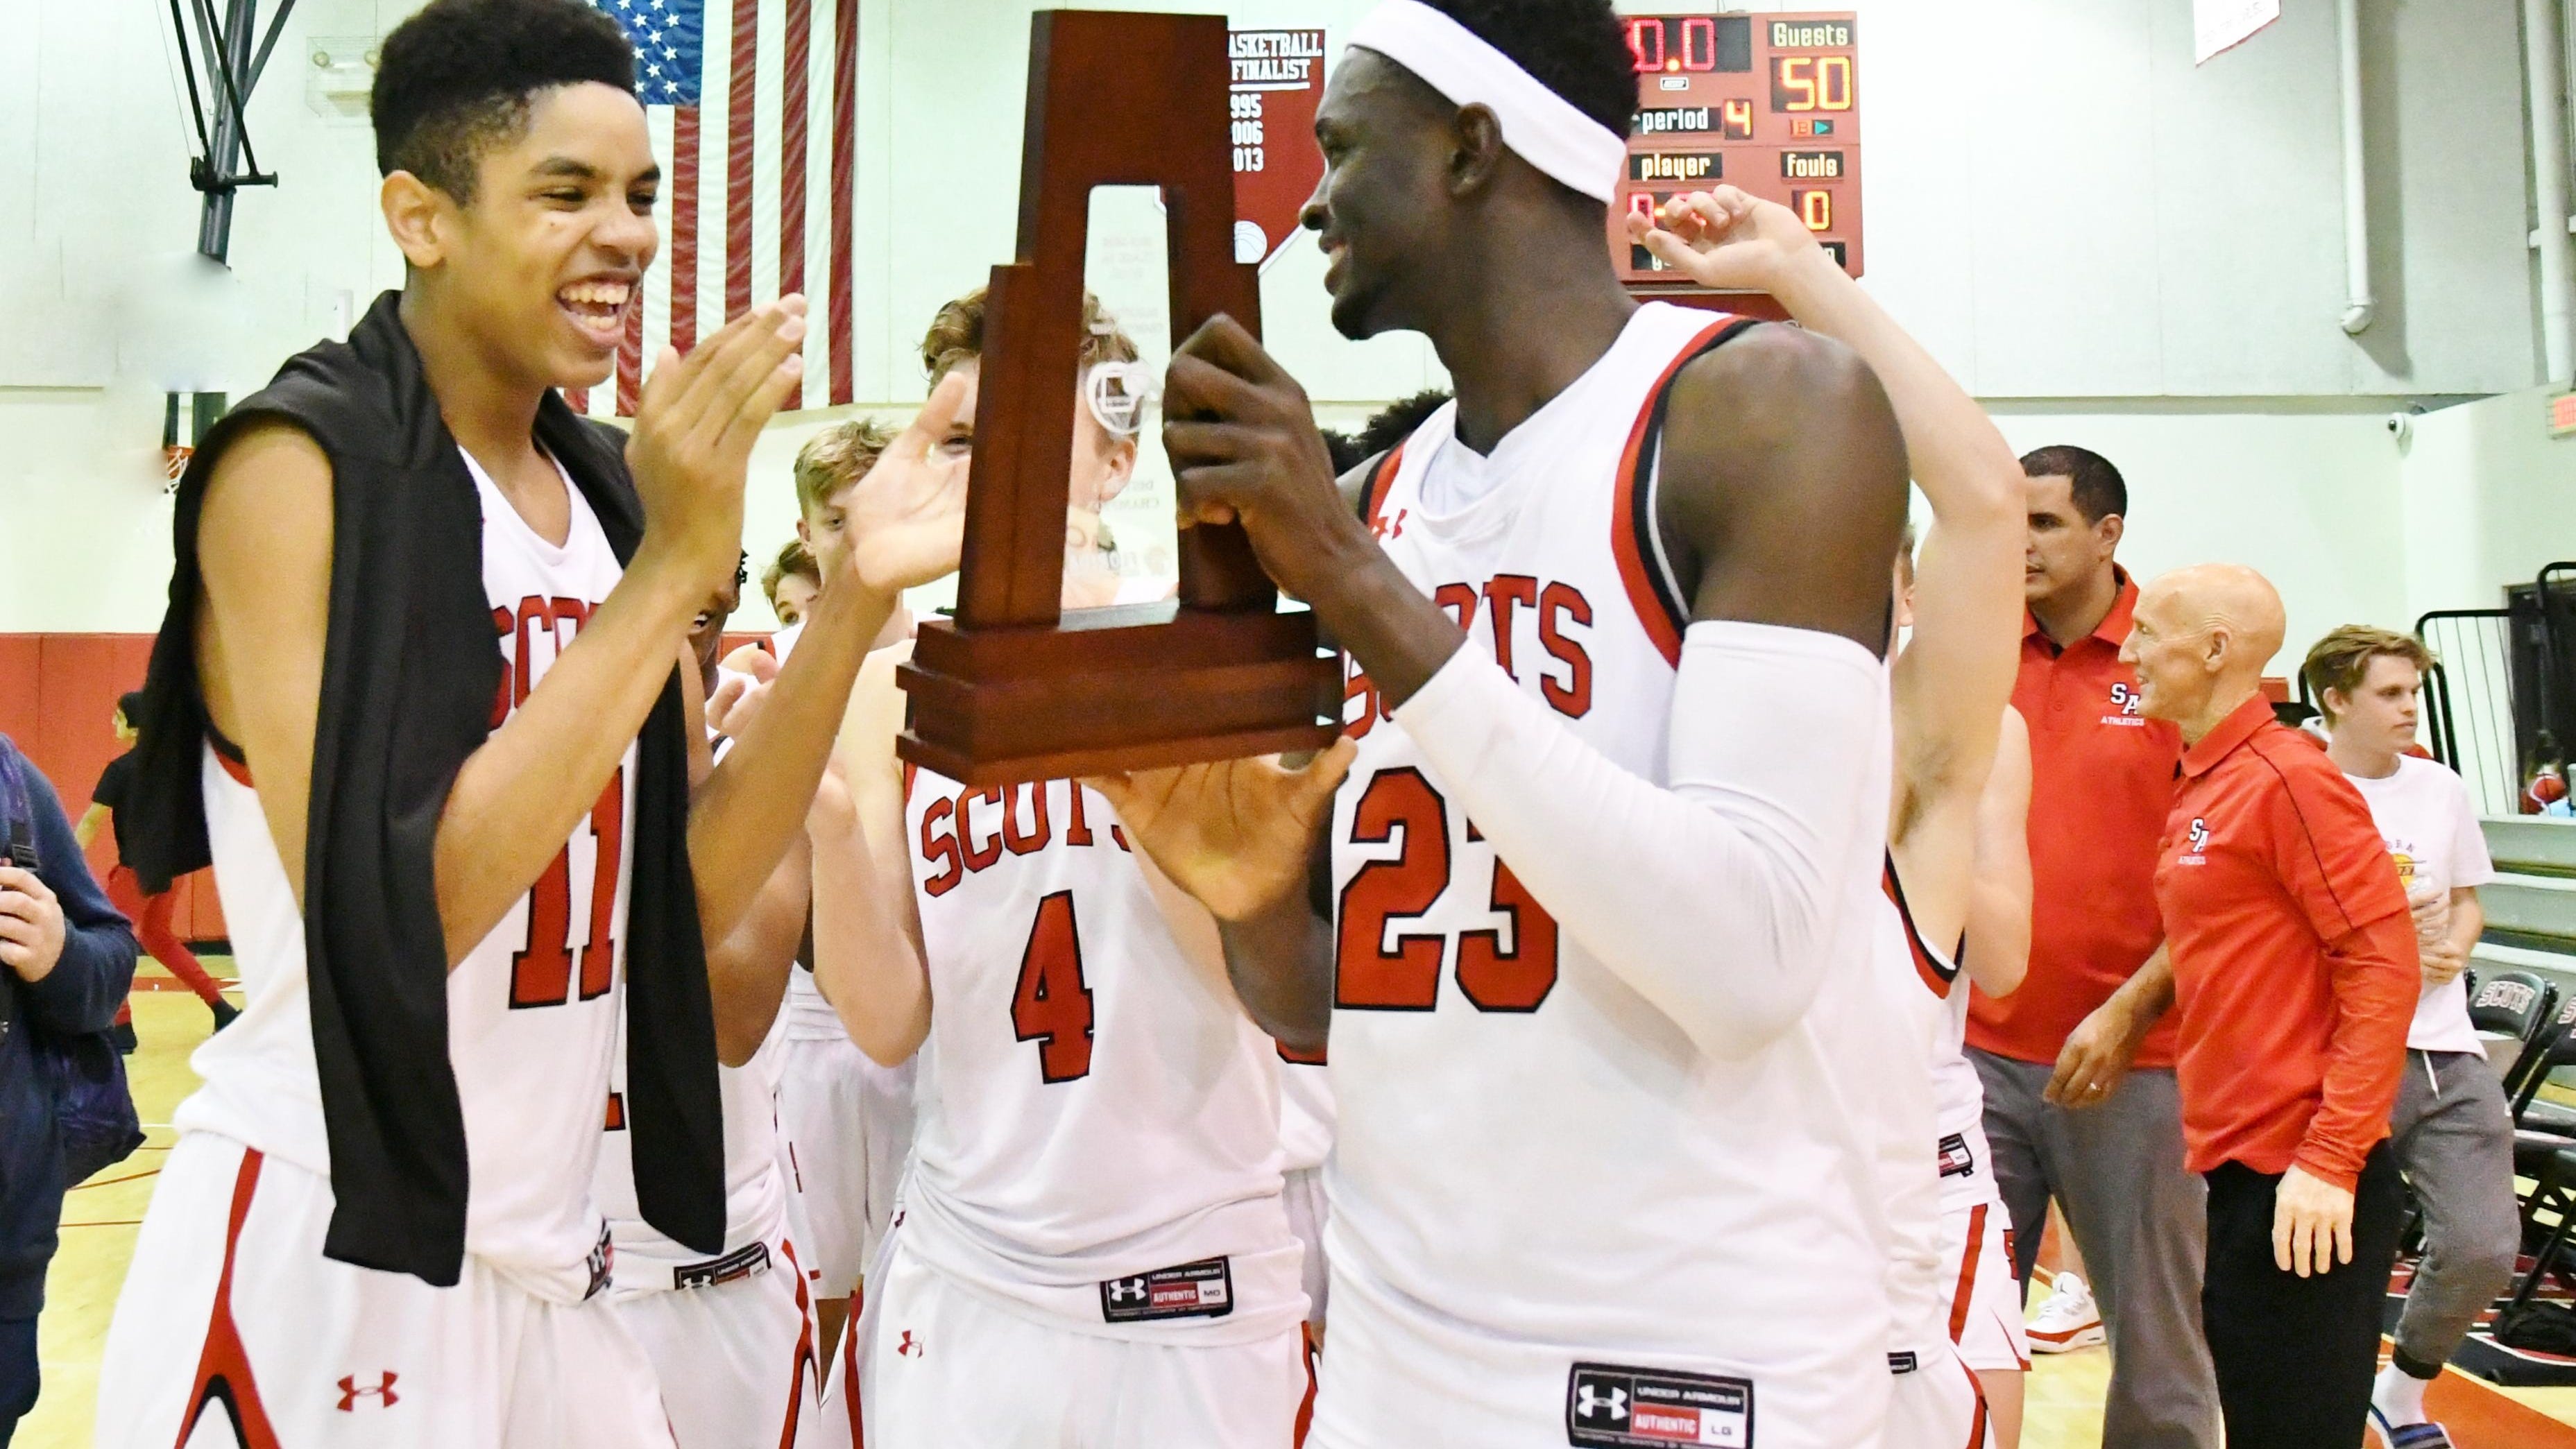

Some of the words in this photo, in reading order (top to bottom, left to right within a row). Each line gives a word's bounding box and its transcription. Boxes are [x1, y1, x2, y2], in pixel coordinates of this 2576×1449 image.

[1228, 33, 1322, 58] ASKETBALL
[1774, 22, 1848, 47] Guests
[1231, 59, 1311, 80] FINALIST
[1781, 56, 1850, 110] 50
[1230, 94, 1262, 119] 995
[1641, 108, 1709, 135] period
[1726, 101, 1751, 135] 4
[1231, 120, 1263, 145] 006
[1233, 147, 1264, 172] 013
[1641, 154, 1711, 181] player
[1787, 153, 1838, 178] fouls
[1805, 191, 1829, 231] 0
[1334, 766, 1558, 1013] 23
[1010, 889, 1095, 1084] 4
[2475, 980, 2536, 1015] SCOTS
[1152, 1271, 1182, 1280] UNDER
[1184, 1269, 1222, 1277] ARMOUR
[1153, 1289, 1197, 1303] AUTHENTIC
[1637, 1387, 1680, 1399] UNDER
[1682, 1390, 1741, 1405] ARMOUR
[1635, 1414, 1697, 1434] AUTHENTIC
